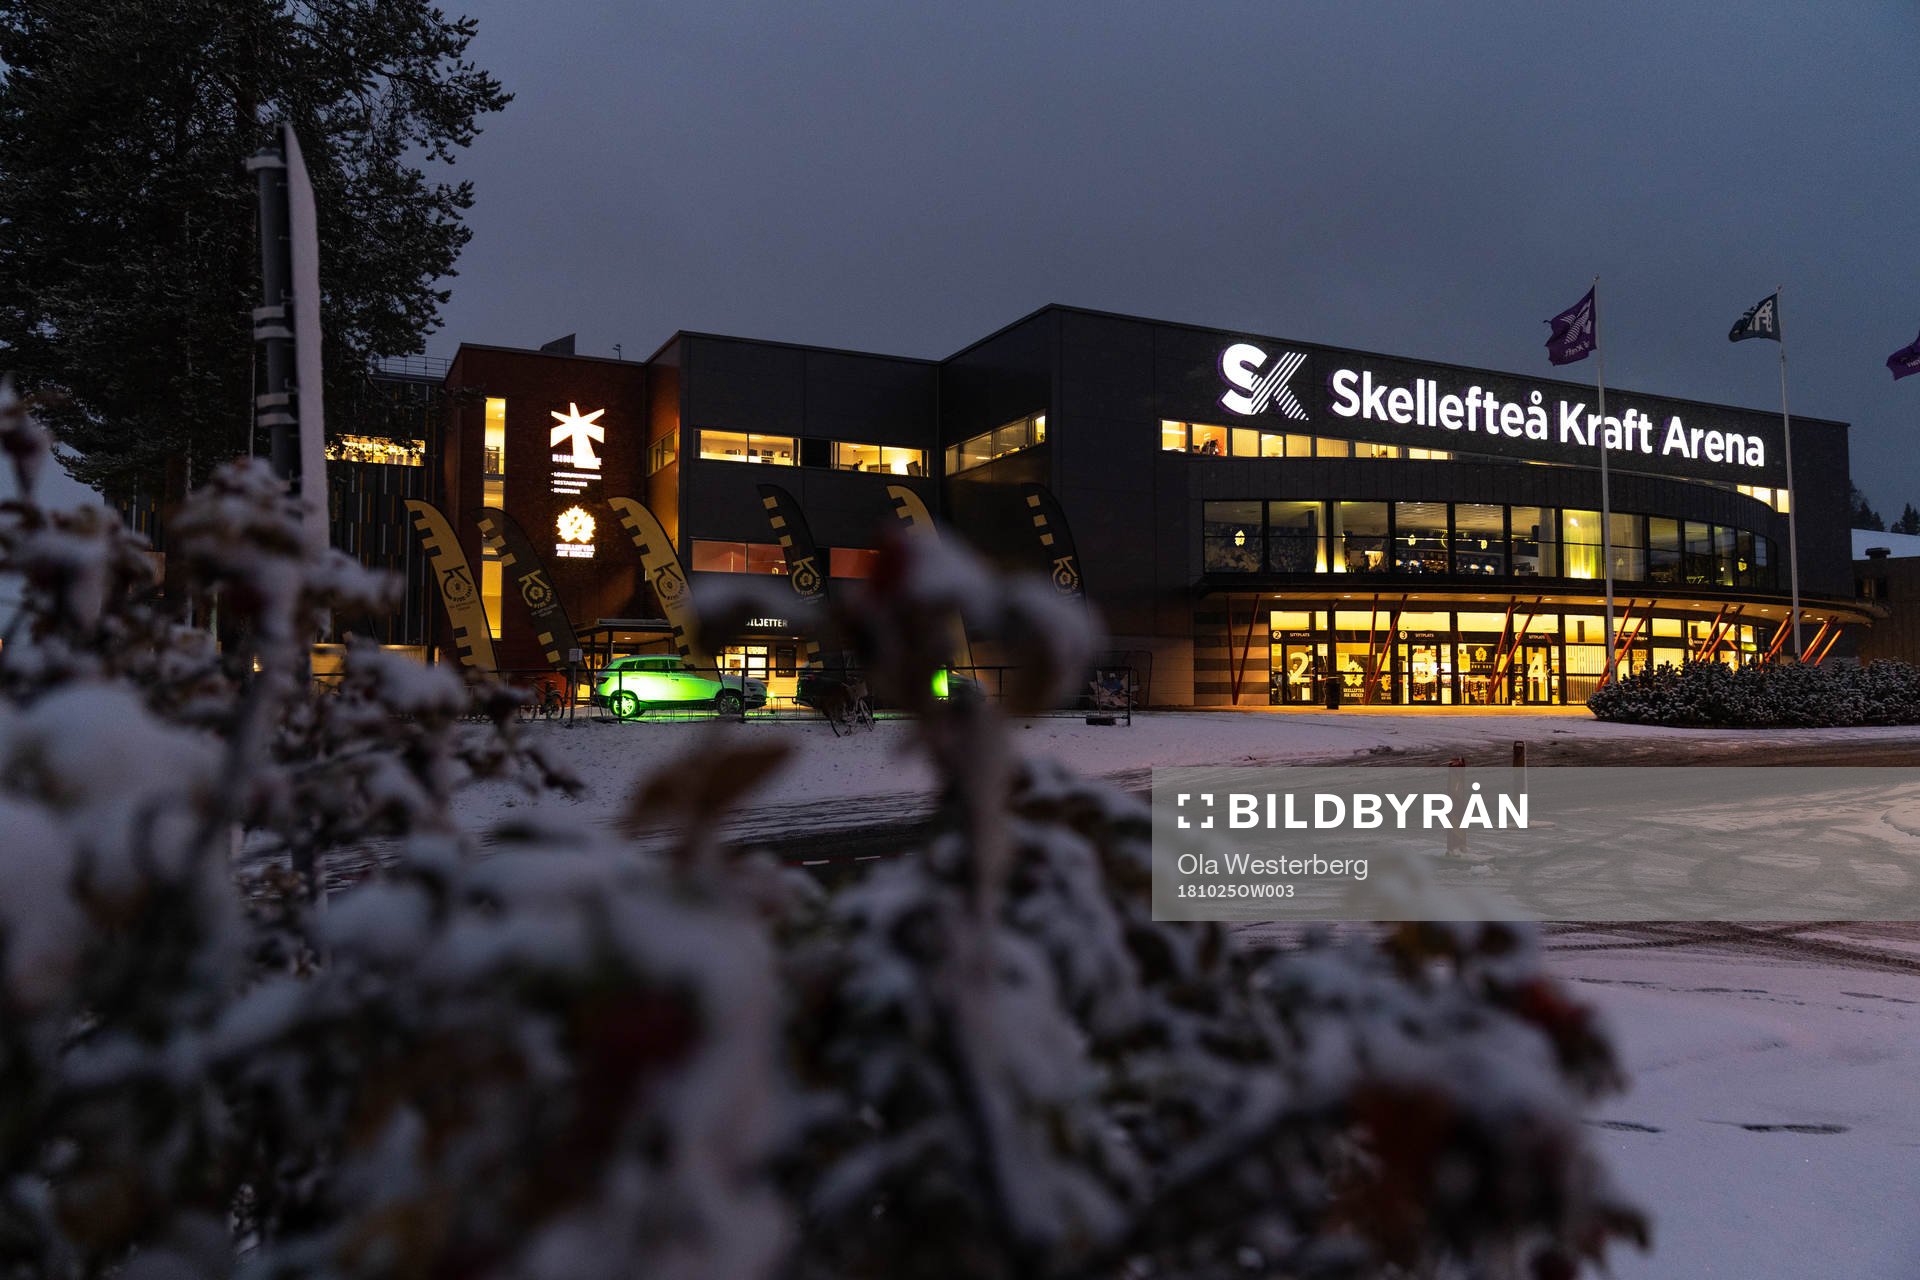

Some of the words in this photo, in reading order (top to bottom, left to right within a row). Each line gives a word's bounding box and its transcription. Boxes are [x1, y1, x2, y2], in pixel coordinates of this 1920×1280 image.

[1331, 369, 1548, 441] Skellefteå
[1559, 400, 1654, 455] Kraft
[1662, 415, 1766, 468] Arena
[1289, 651, 1310, 683] 2
